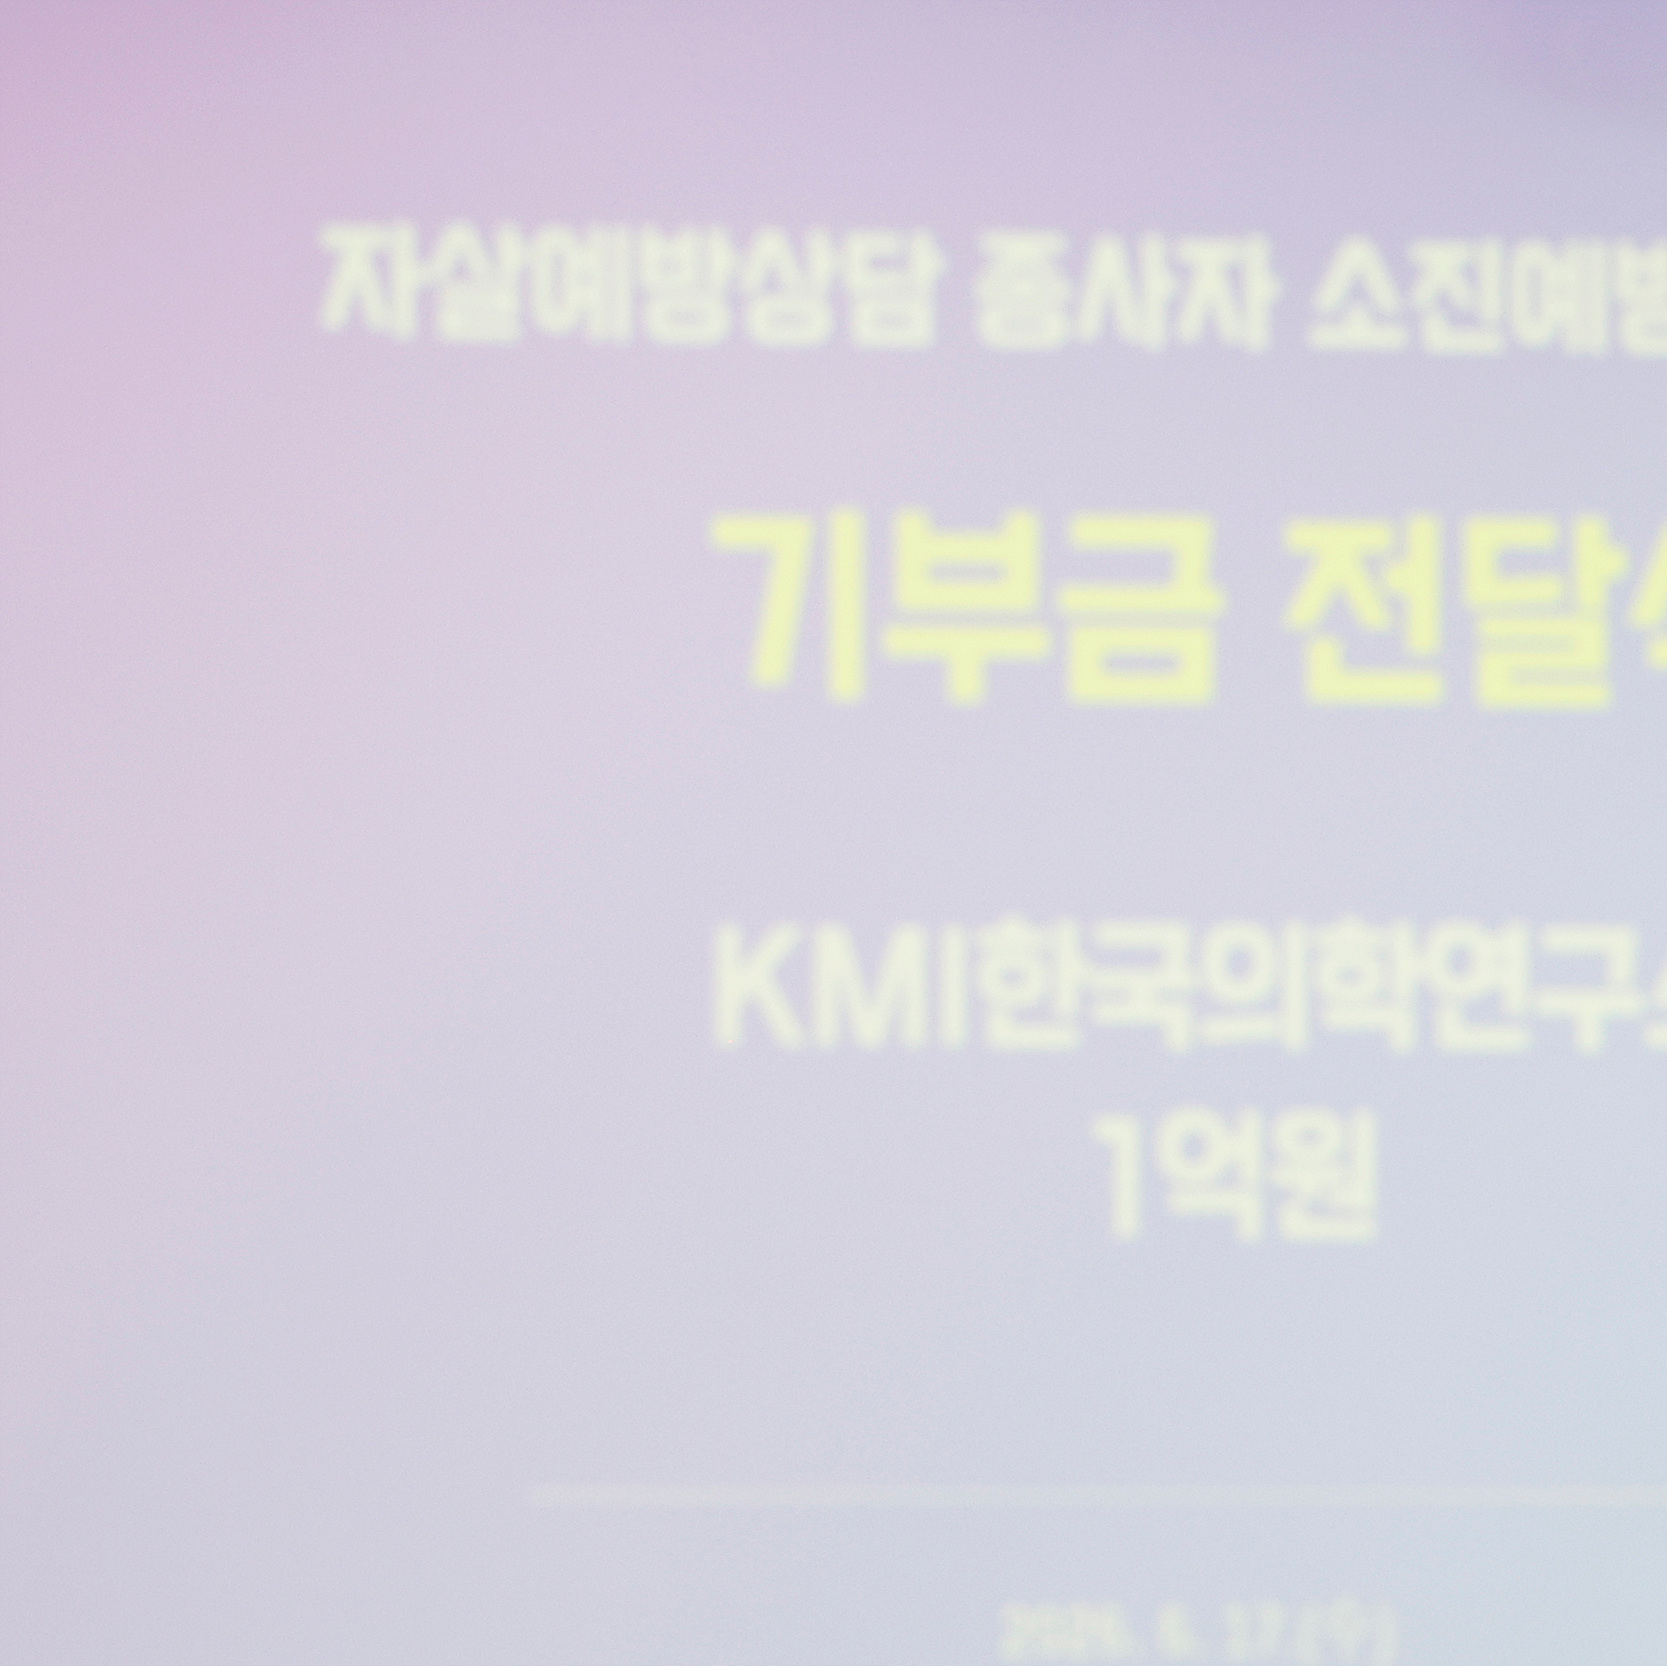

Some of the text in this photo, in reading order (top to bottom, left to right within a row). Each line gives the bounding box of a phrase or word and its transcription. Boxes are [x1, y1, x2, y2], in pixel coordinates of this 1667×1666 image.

[320, 219, 946, 346] 자살예방상담
[976, 228, 1280, 352] 종사자
[710, 508, 1225, 705] 기부금
[1092, 1107, 1378, 1242] 1억원
